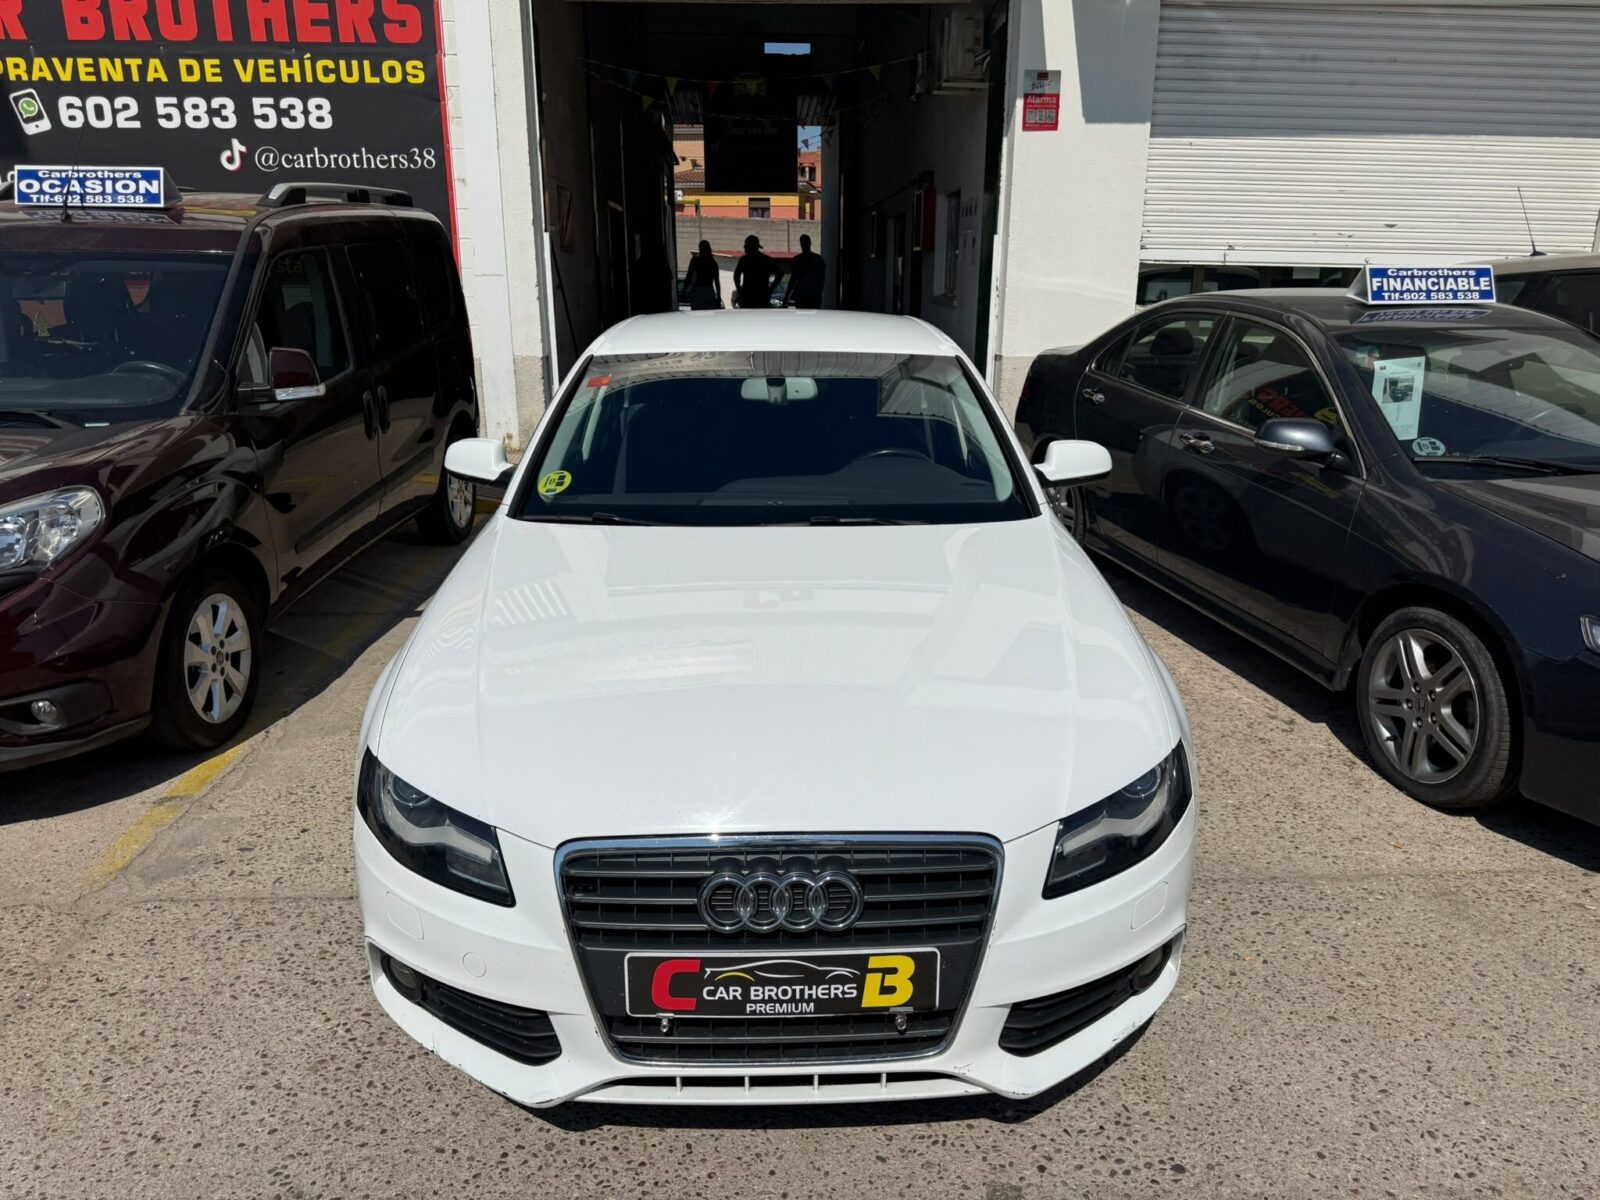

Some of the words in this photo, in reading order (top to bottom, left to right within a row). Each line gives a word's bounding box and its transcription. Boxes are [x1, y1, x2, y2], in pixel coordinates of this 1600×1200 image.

[61, 0, 422, 43] BROTHERS
[0, 57, 168, 82] RAVENTA
[178, 58, 221, 83] DE
[233, 53, 426, 84] VEHÍCULOS
[1026, 95, 1057, 104] Alarma
[57, 96, 141, 129] 602
[157, 96, 238, 129] 583
[252, 97, 333, 130] 538
[254, 145, 436, 172] @carbrothers38
[38, 170, 142, 179] Carbrothers
[18, 179, 159, 194] OCASION
[85, 194, 113, 203] 583
[117, 194, 144, 203] 538
[1387, 268, 1476, 276] Carbrothers
[1371, 277, 1491, 291] FINANCIABLE
[1382, 292, 1427, 300] Tlf-602
[1430, 292, 1453, 300] 583
[1457, 292, 1480, 300] 538
[651, 959, 701, 1010] C
[861, 954, 915, 1008] B
[702, 986, 742, 1001] CAR
[750, 983, 858, 1001] BROTHERS
[745, 1002, 815, 1014] PREMIUM
